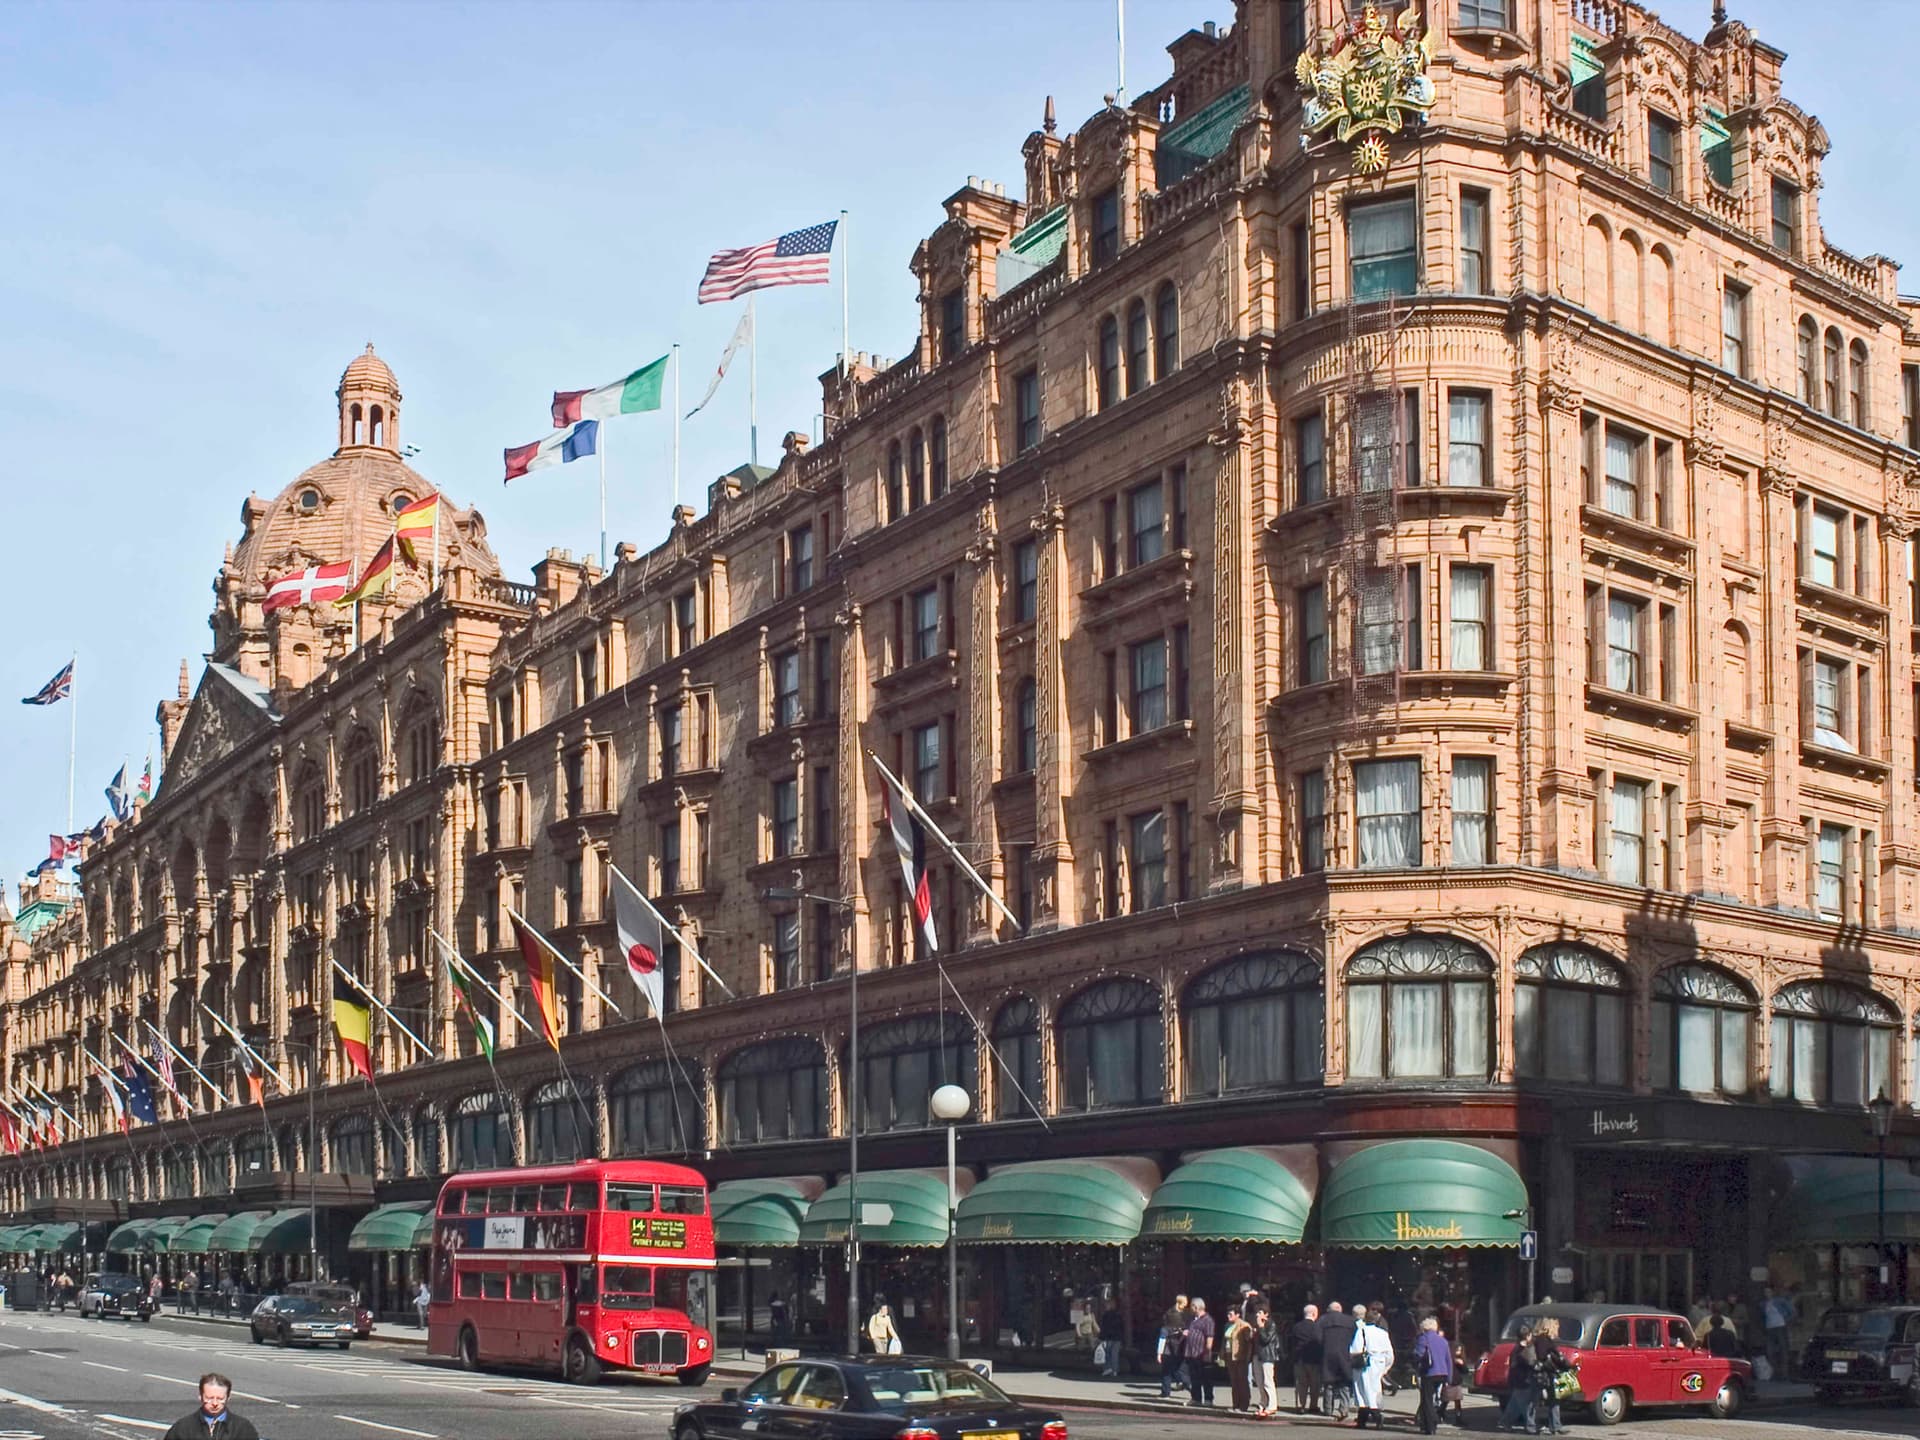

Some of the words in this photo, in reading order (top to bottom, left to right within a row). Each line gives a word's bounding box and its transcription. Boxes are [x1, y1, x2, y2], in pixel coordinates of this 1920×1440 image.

[1588, 1110, 1639, 1135] Harrods
[632, 1218, 646, 1231] 14
[1153, 1212, 1194, 1232] Harrods
[1391, 1212, 1463, 1241] Harrods
